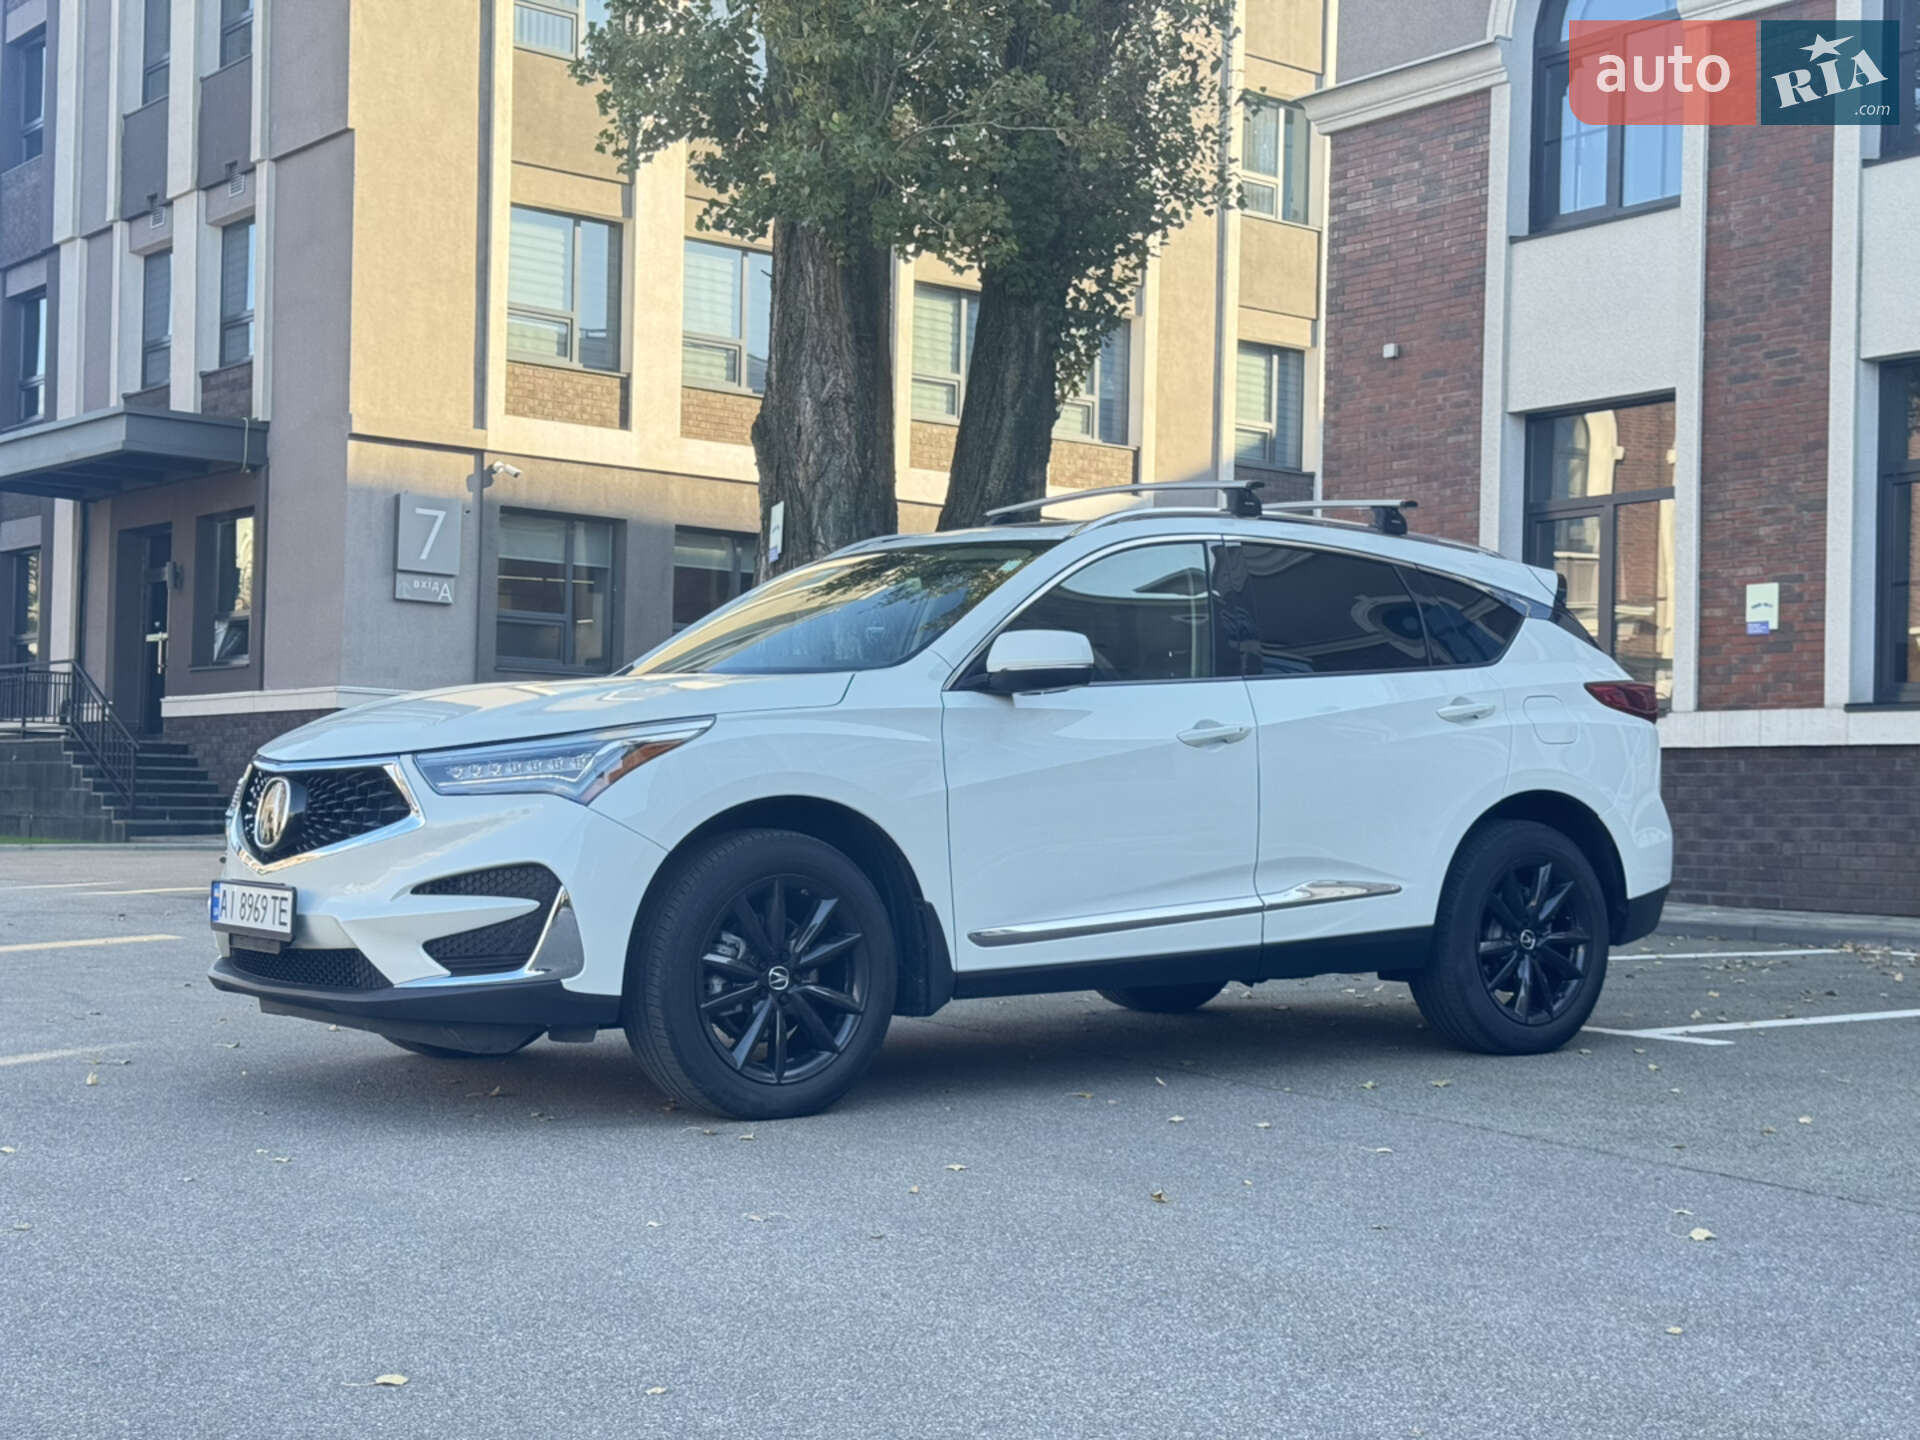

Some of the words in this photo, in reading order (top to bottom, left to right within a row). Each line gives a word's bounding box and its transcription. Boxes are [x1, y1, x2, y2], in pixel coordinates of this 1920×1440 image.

[415, 507, 446, 560] 7
[221, 889, 235, 919] AI
[240, 892, 268, 923] 8969
[271, 896, 288, 926] TE
